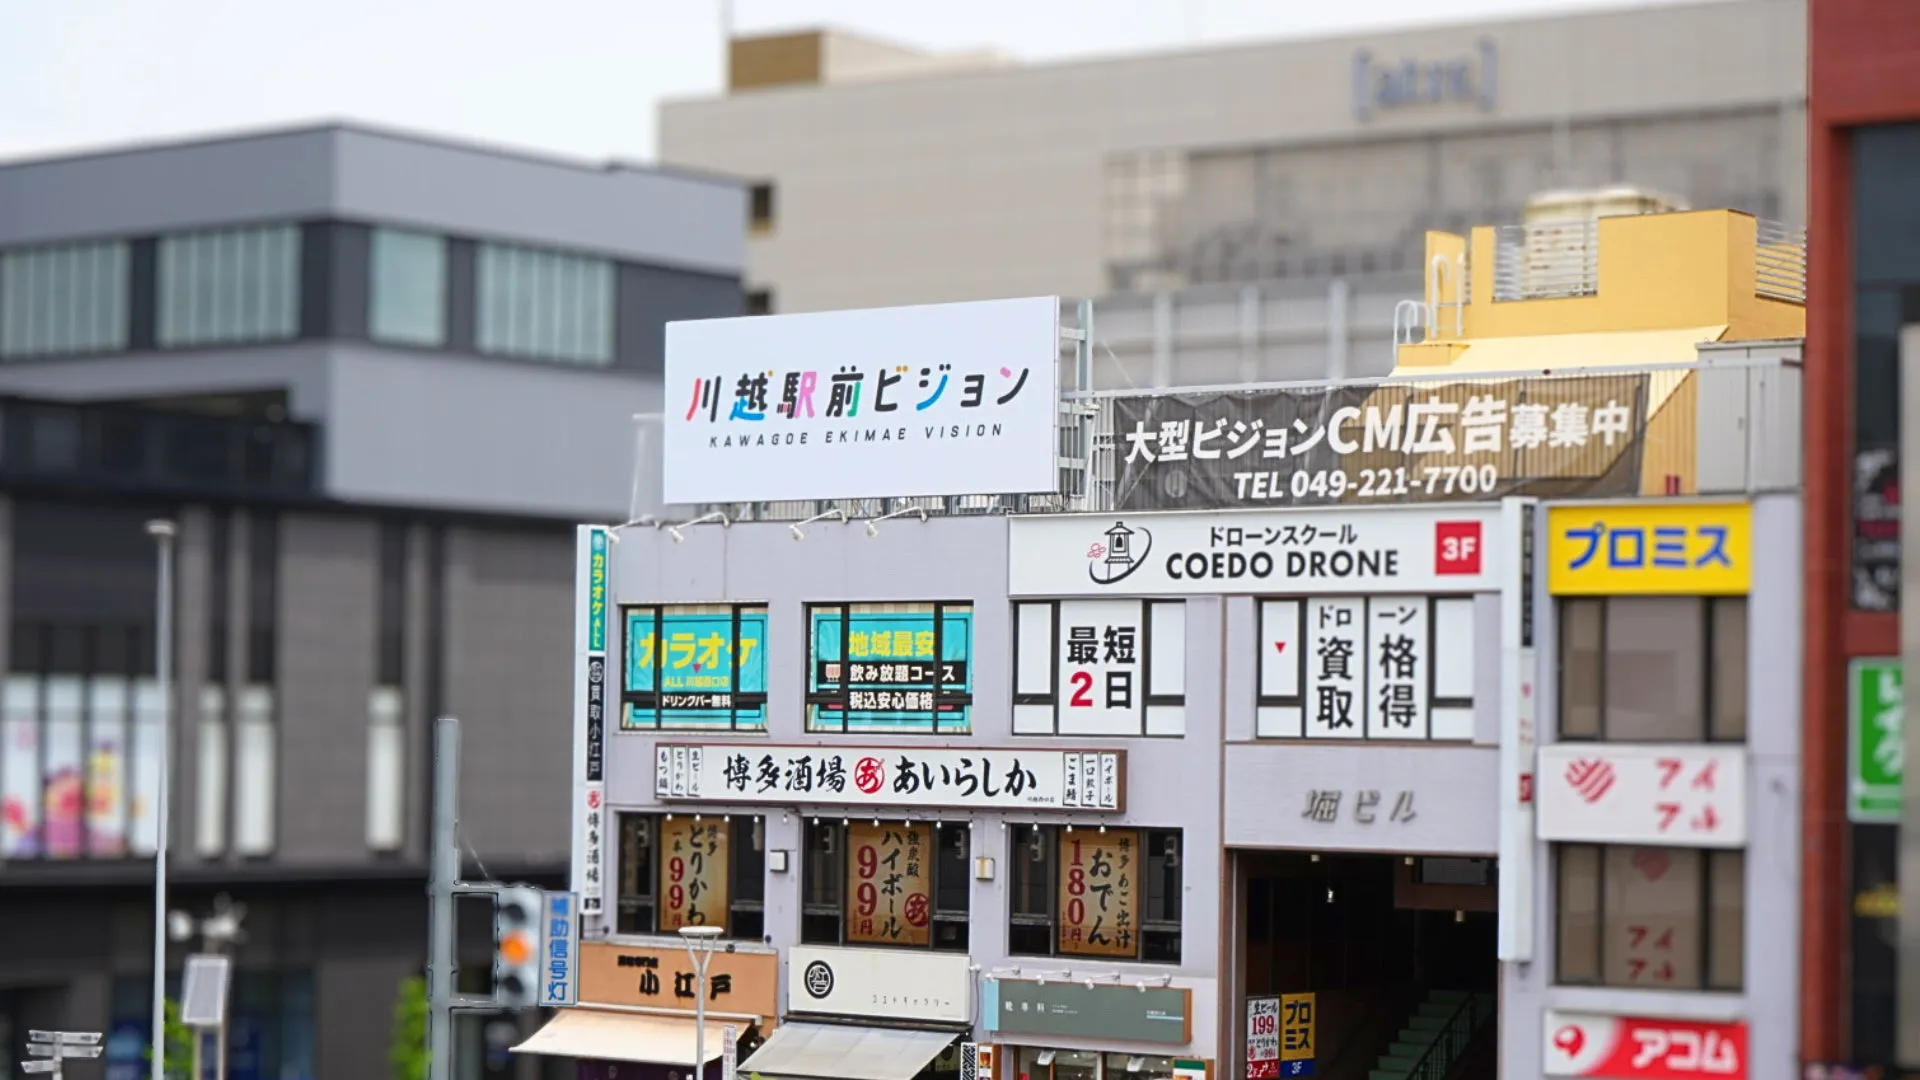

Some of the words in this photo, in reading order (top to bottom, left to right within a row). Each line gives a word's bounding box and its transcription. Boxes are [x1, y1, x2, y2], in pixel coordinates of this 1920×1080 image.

[686, 363, 1029, 422] 川越駅前ビジョン
[709, 431, 808, 448] KAWAGOE
[825, 427, 907, 443] EKIMAE
[925, 423, 1003, 438] VISION
[1233, 471, 1284, 499] TEL
[1290, 465, 1497, 498] 049-221-7700
[1209, 523, 1358, 548] ドローンスクール
[1441, 537, 1476, 561] 3F
[1565, 522, 1732, 569] プロミス
[1165, 550, 1274, 580] COEDO
[1286, 549, 1398, 578] DRONE
[592, 554, 604, 615] カラオケ
[639, 632, 758, 669] カラオケ
[849, 631, 934, 657] 地域最安
[1067, 625, 1136, 664] 最短
[850, 664, 955, 682] 飲み放題コース
[1070, 671, 1132, 709] 2日
[662, 695, 731, 708] ドリンクバー無料
[850, 692, 933, 710] 税込安心価格
[723, 753, 847, 794] 博多酒場
[894, 755, 1036, 797] あいらしか
[1104, 757, 1113, 802] ハイボール
[587, 813, 601, 883] 博多酒場
[906, 831, 920, 878] 強炭酸
[687, 824, 708, 926] とりかわ
[857, 845, 877, 935] 99円
[881, 831, 904, 938] ハイボール
[1116, 837, 1131, 948] 博多あご出汁
[1088, 848, 1114, 946] おでん
[639, 969, 731, 1000] 小江戸
[1291, 1062, 1303, 1075] 3F
[1631, 1027, 1740, 1074] アコム
